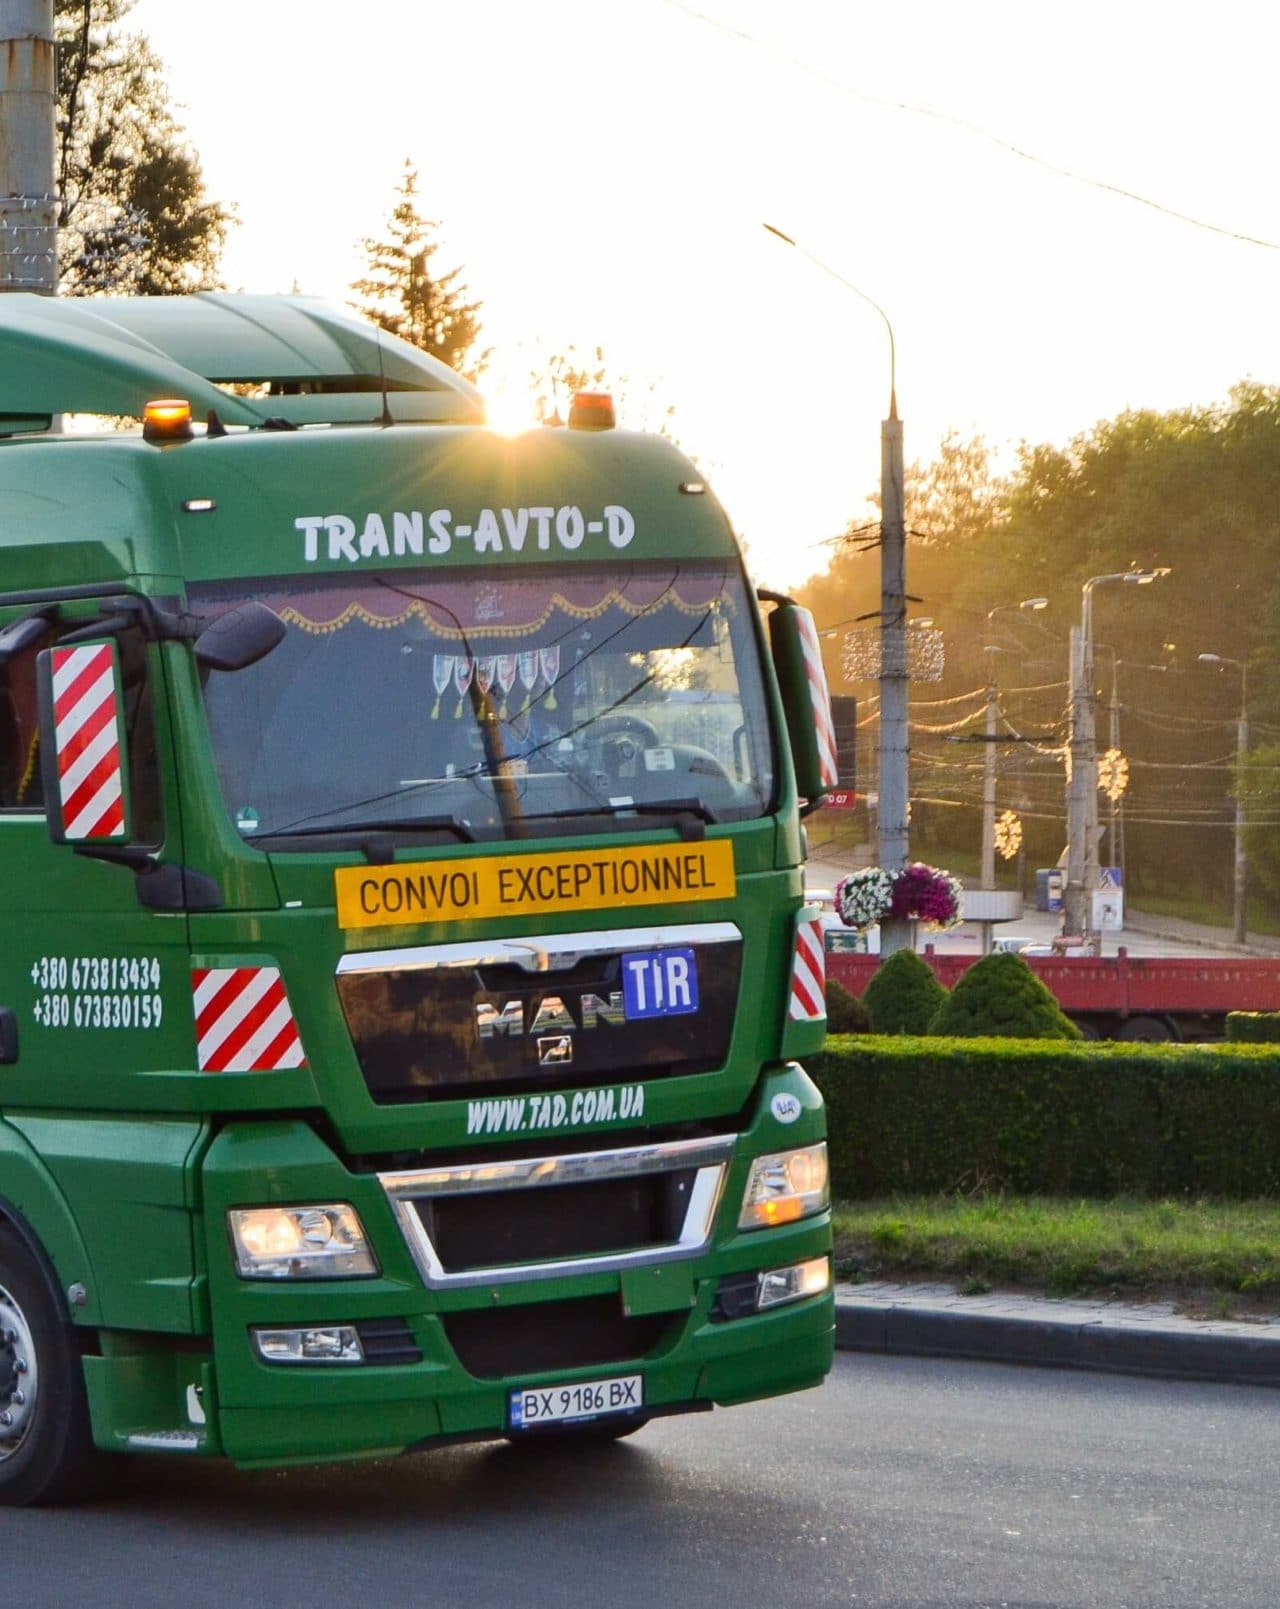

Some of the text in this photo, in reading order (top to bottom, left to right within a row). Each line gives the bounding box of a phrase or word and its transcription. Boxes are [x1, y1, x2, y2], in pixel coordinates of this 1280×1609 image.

[295, 505, 636, 563] TRANS-AVTO-D
[359, 854, 716, 914] CONVOI EXCEPTIONNEL
[31, 957, 161, 990] +380 673813434
[629, 955, 692, 1012] TIR
[33, 994, 162, 1028] +380 673830159
[476, 991, 626, 1039] MAN
[467, 1085, 645, 1136] WWW.TAD.COM.UA
[524, 1380, 637, 1418] BX 9186 BX
